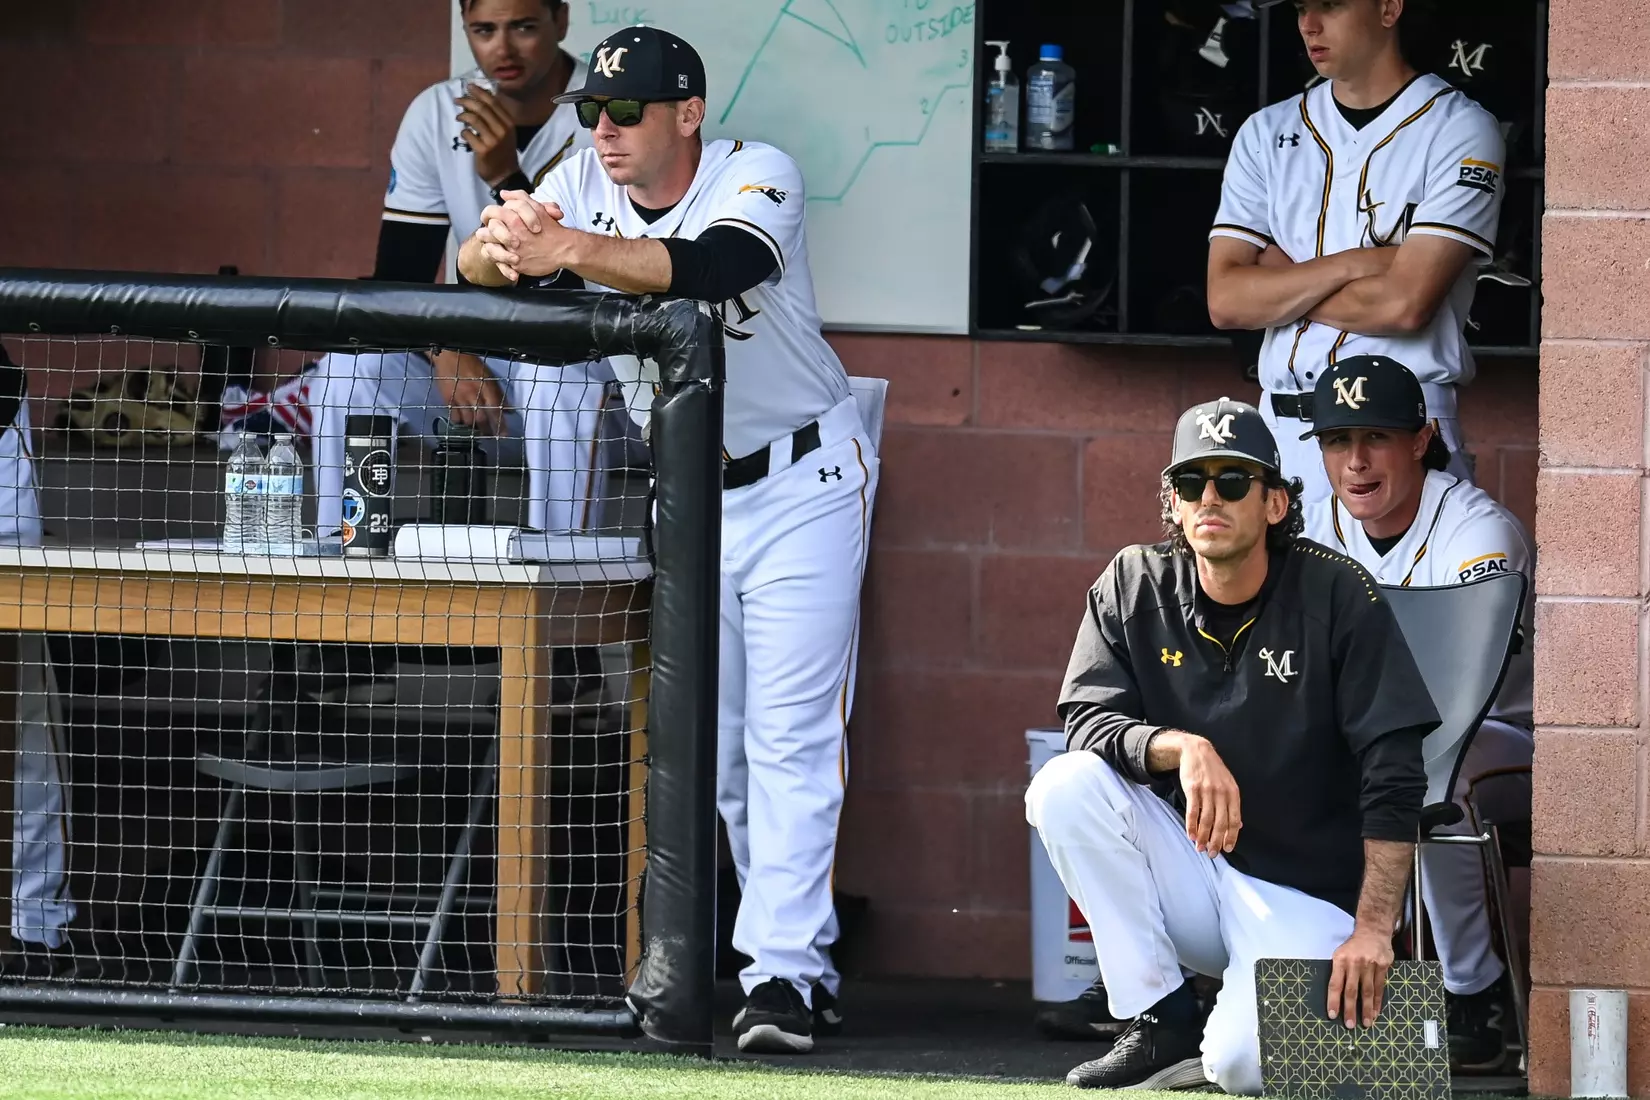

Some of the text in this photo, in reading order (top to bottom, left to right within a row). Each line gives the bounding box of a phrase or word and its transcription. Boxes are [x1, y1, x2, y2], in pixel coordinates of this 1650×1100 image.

[885, 4, 974, 44] OUTSIDE
[594, 47, 628, 78] M
[956, 48, 968, 68] 3
[1459, 166, 1499, 188] PSAC
[1333, 376, 1368, 410] M
[1196, 412, 1236, 444] M
[370, 513, 389, 533] 23
[1459, 559, 1508, 583] PSAC
[1258, 647, 1295, 683] M
[1064, 955, 1097, 966] Official
